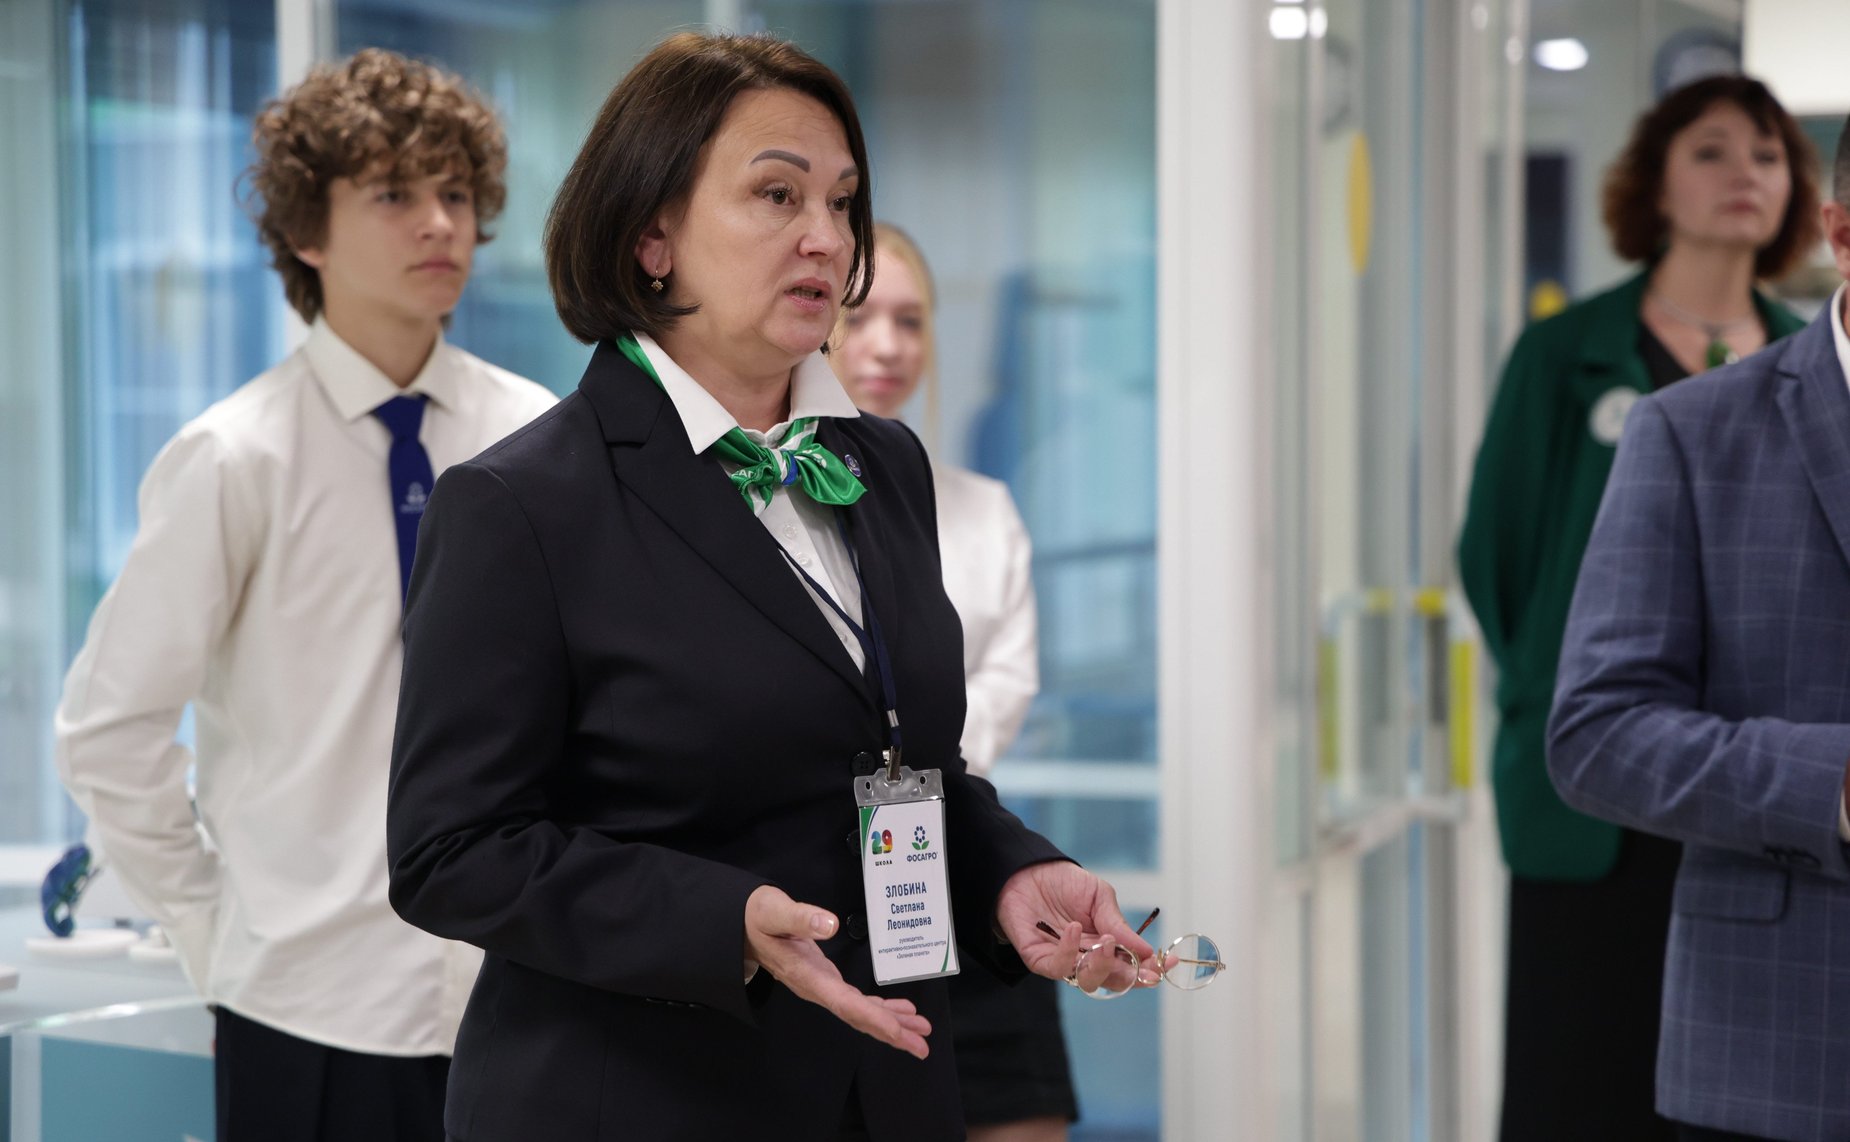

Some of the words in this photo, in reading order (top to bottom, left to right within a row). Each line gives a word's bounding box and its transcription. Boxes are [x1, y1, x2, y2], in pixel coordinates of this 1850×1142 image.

[871, 829, 893, 855] 29
[906, 852, 938, 862] ФОСАГРО
[885, 881, 927, 898] ЗЛОБИНА
[891, 902, 925, 914] Светлана
[887, 916, 932, 931] Леонидовна
